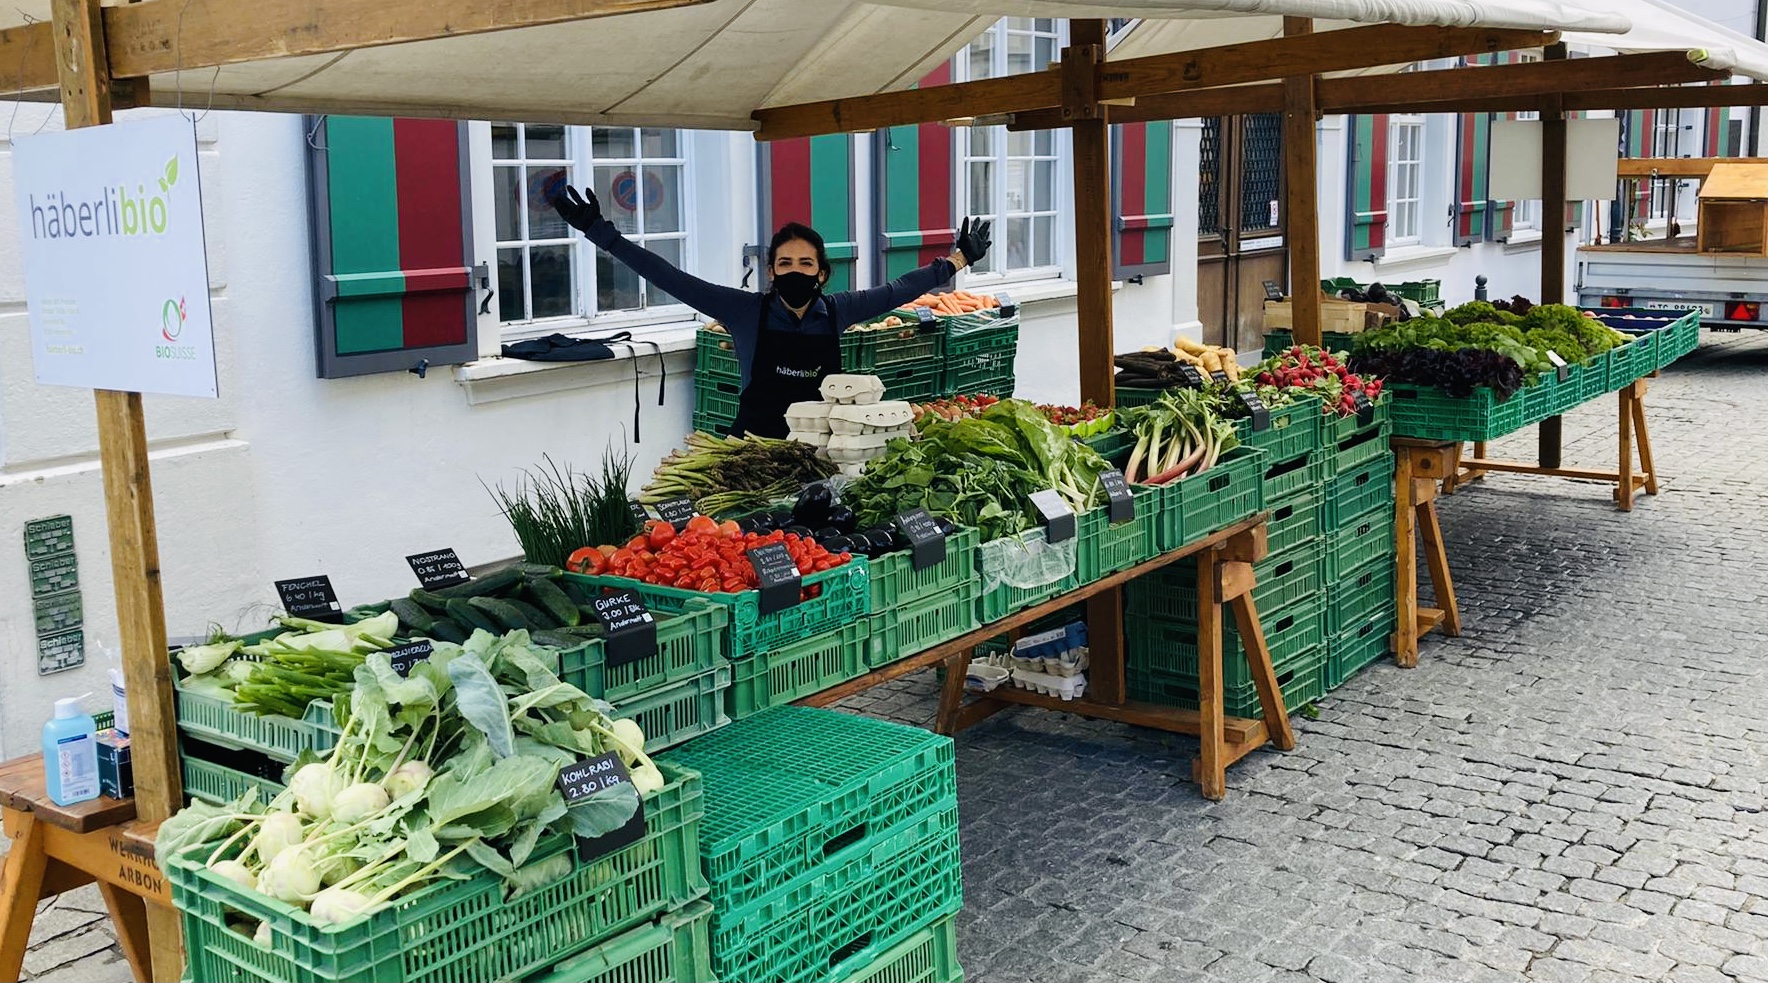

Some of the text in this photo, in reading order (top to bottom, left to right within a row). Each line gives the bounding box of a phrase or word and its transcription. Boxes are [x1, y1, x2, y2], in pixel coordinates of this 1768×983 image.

[30, 184, 167, 239] häberlibio
[595, 593, 631, 611] GURKE
[562, 758, 614, 785] KOHLRABI
[568, 781, 597, 798] 2.80
[118, 864, 162, 894] ARBON
